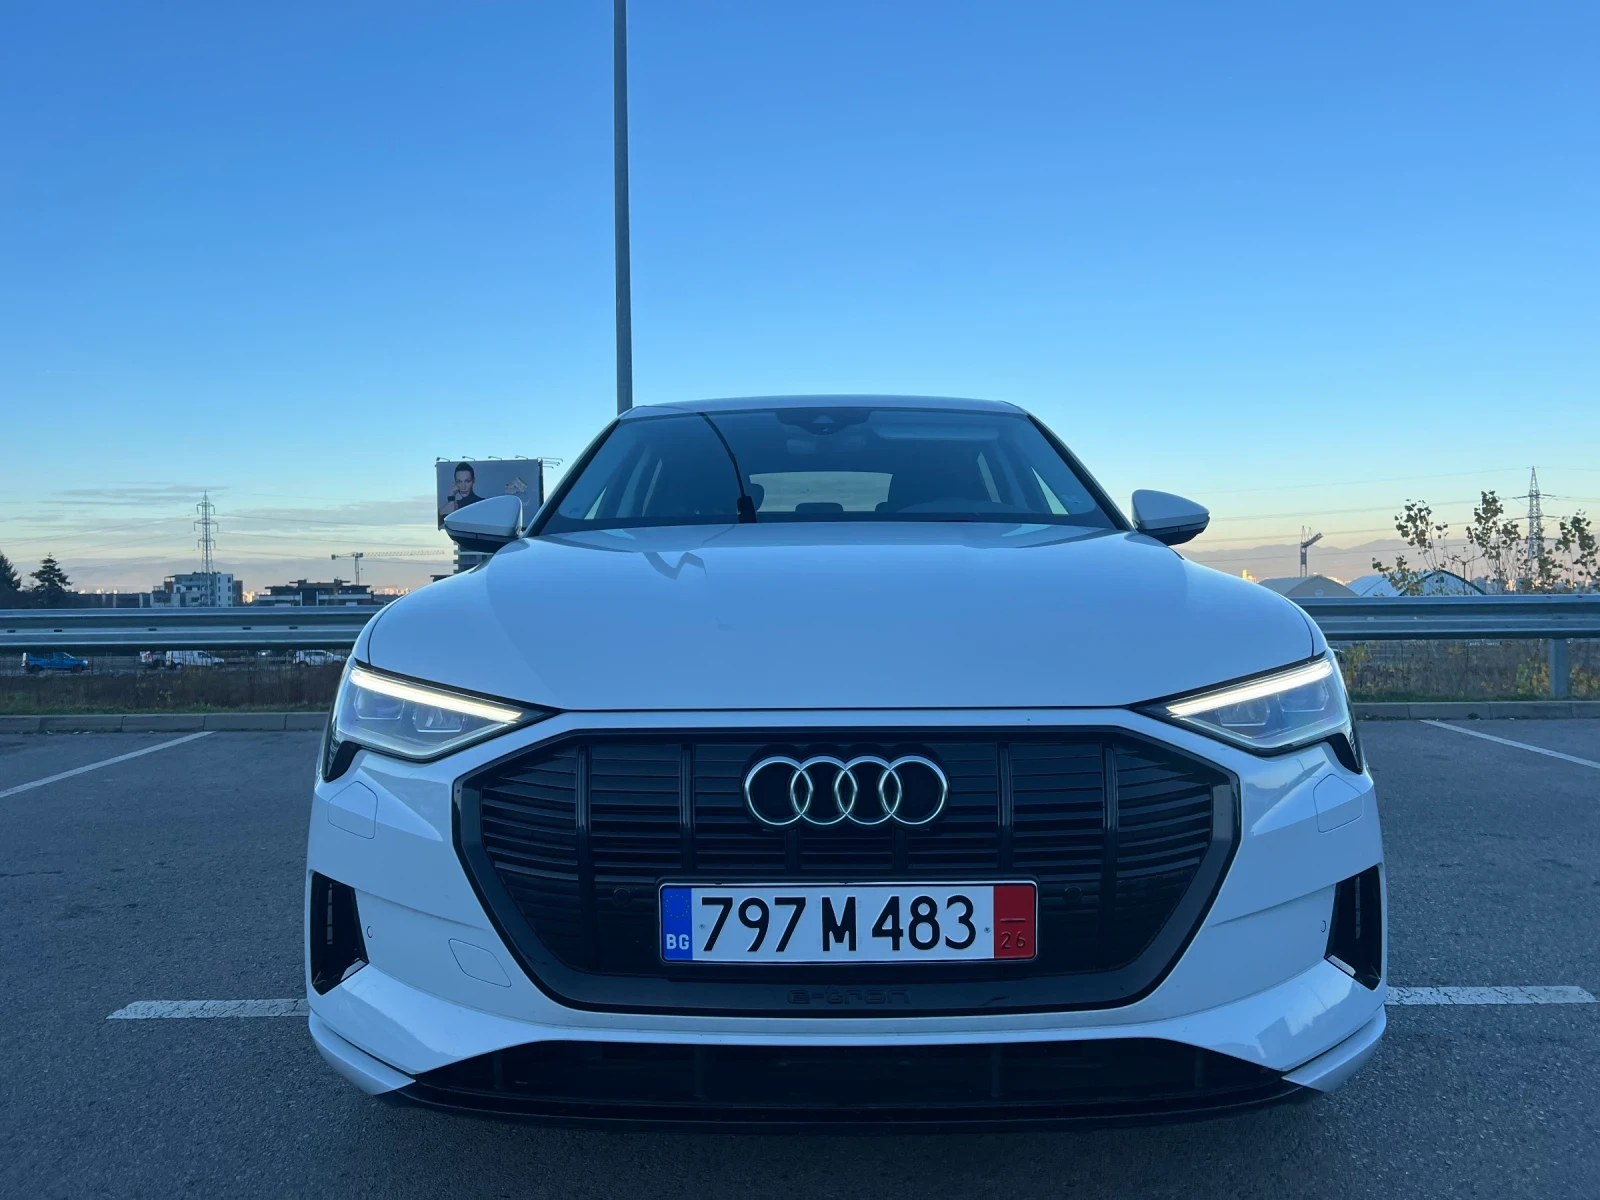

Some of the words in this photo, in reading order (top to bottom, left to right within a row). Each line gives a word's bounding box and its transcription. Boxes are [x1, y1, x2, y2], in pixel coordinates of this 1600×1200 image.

[701, 896, 807, 953] 797
[821, 896, 858, 952] M
[871, 894, 977, 951] 483
[666, 933, 690, 951] BG
[1000, 931, 1026, 949] 26
[786, 985, 911, 1006] e-tron
